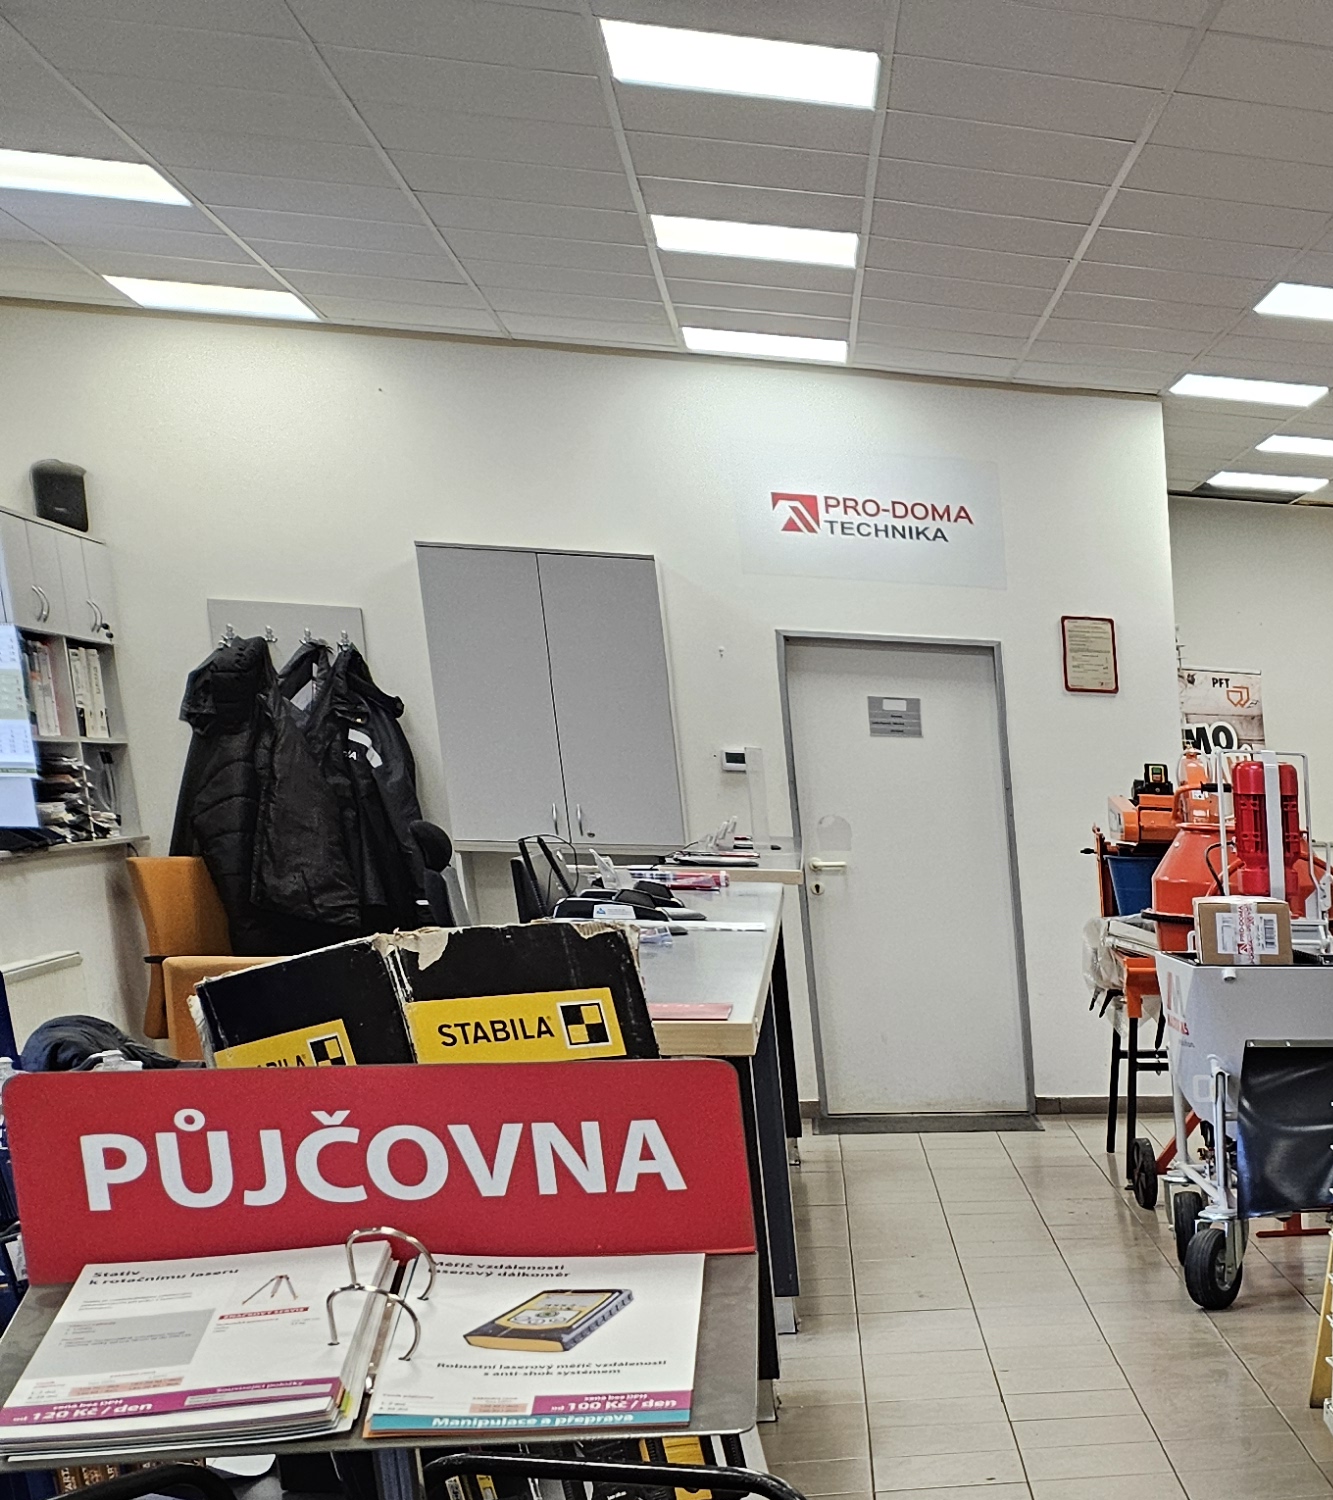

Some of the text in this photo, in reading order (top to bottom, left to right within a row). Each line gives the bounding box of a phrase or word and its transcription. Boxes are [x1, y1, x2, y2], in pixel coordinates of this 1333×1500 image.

[824, 495, 974, 525] PRO-DOMA
[824, 520, 949, 543] TECHNIKA
[1211, 677, 1230, 688] PFT
[437, 1016, 555, 1048] STABILA
[80, 1108, 688, 1212] PŮJČOVNA
[94, 1268, 140, 1278] Stativ
[189, 1268, 239, 1278] laseru
[32, 1409, 68, 1421] 120
[72, 1406, 98, 1418] Kč
[113, 1402, 153, 1414] den
[567, 1401, 601, 1411] 100
[604, 1400, 627, 1411] Kč
[641, 1398, 677, 1409] den
[431, 1415, 536, 1429] Manipulace
[556, 1412, 634, 1427] přeprava
